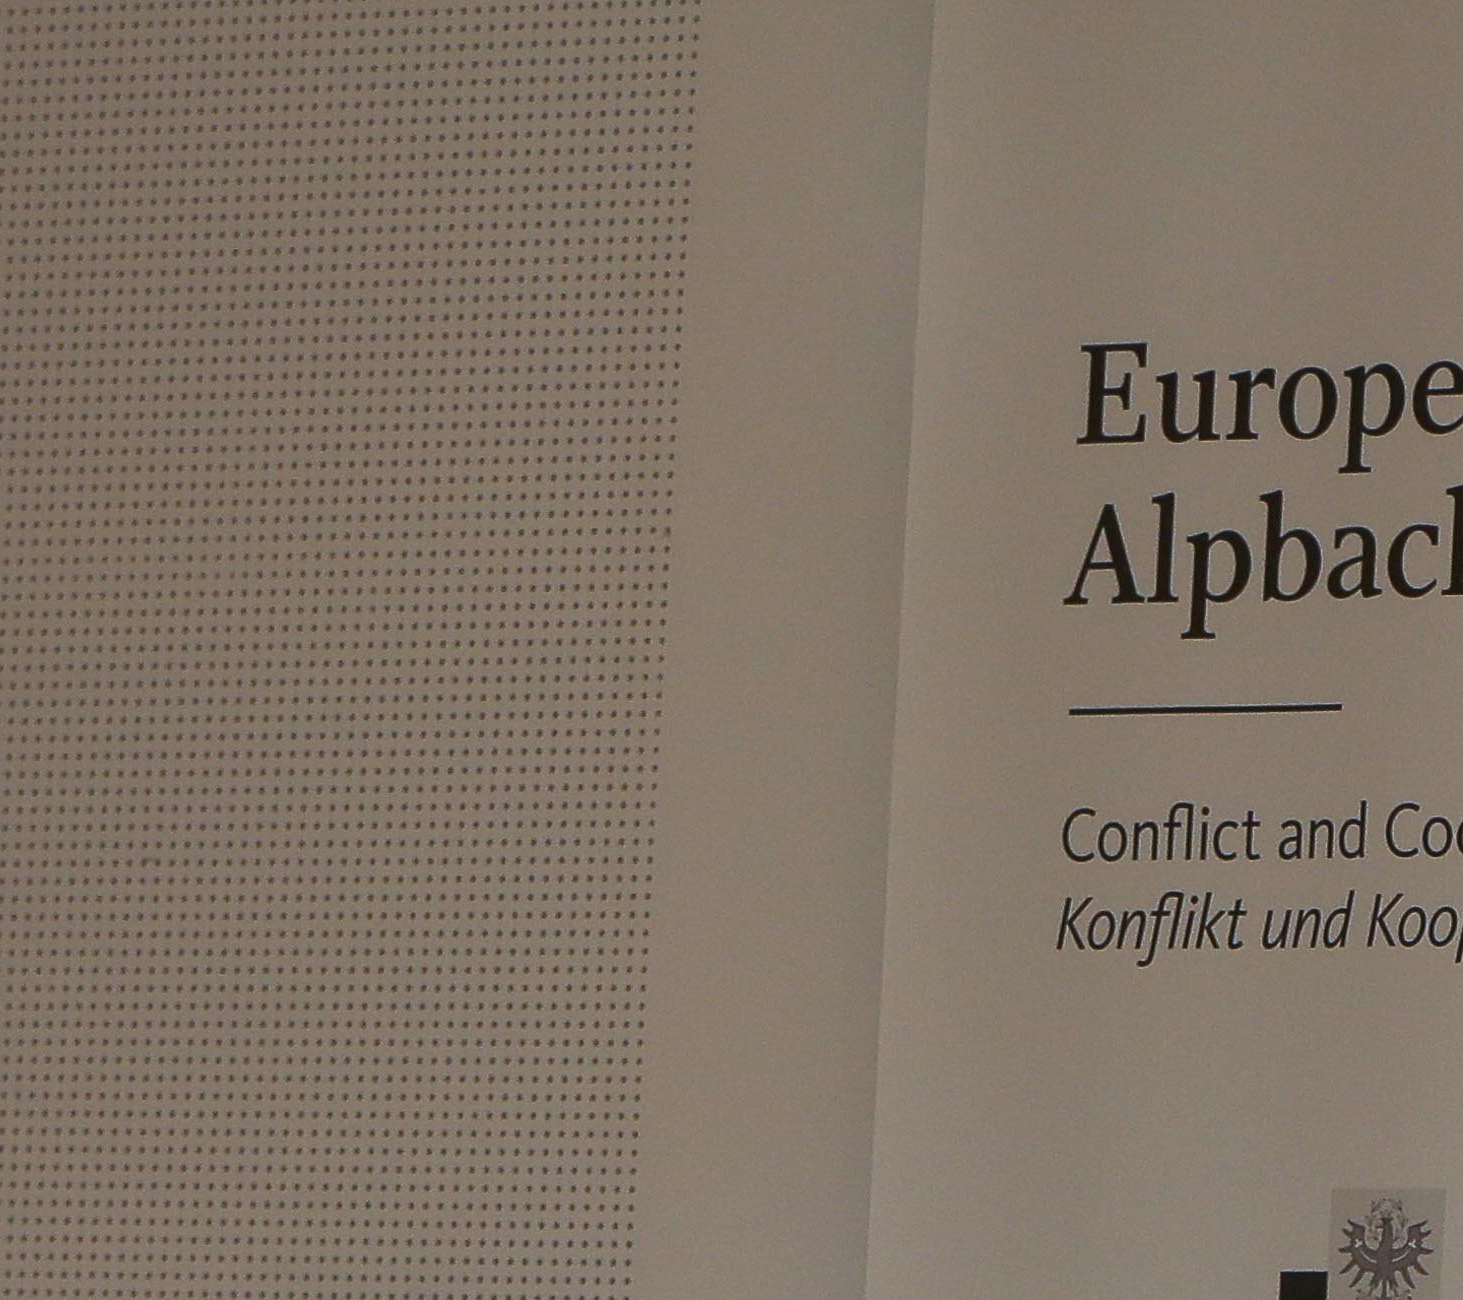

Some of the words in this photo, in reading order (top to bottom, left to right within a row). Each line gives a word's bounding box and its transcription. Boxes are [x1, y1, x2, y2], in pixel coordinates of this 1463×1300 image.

[1061, 801, 1262, 863] Conflict
[1276, 801, 1368, 858] and
[1055, 889, 1249, 968] Konflikt
[1260, 889, 1356, 950] und
